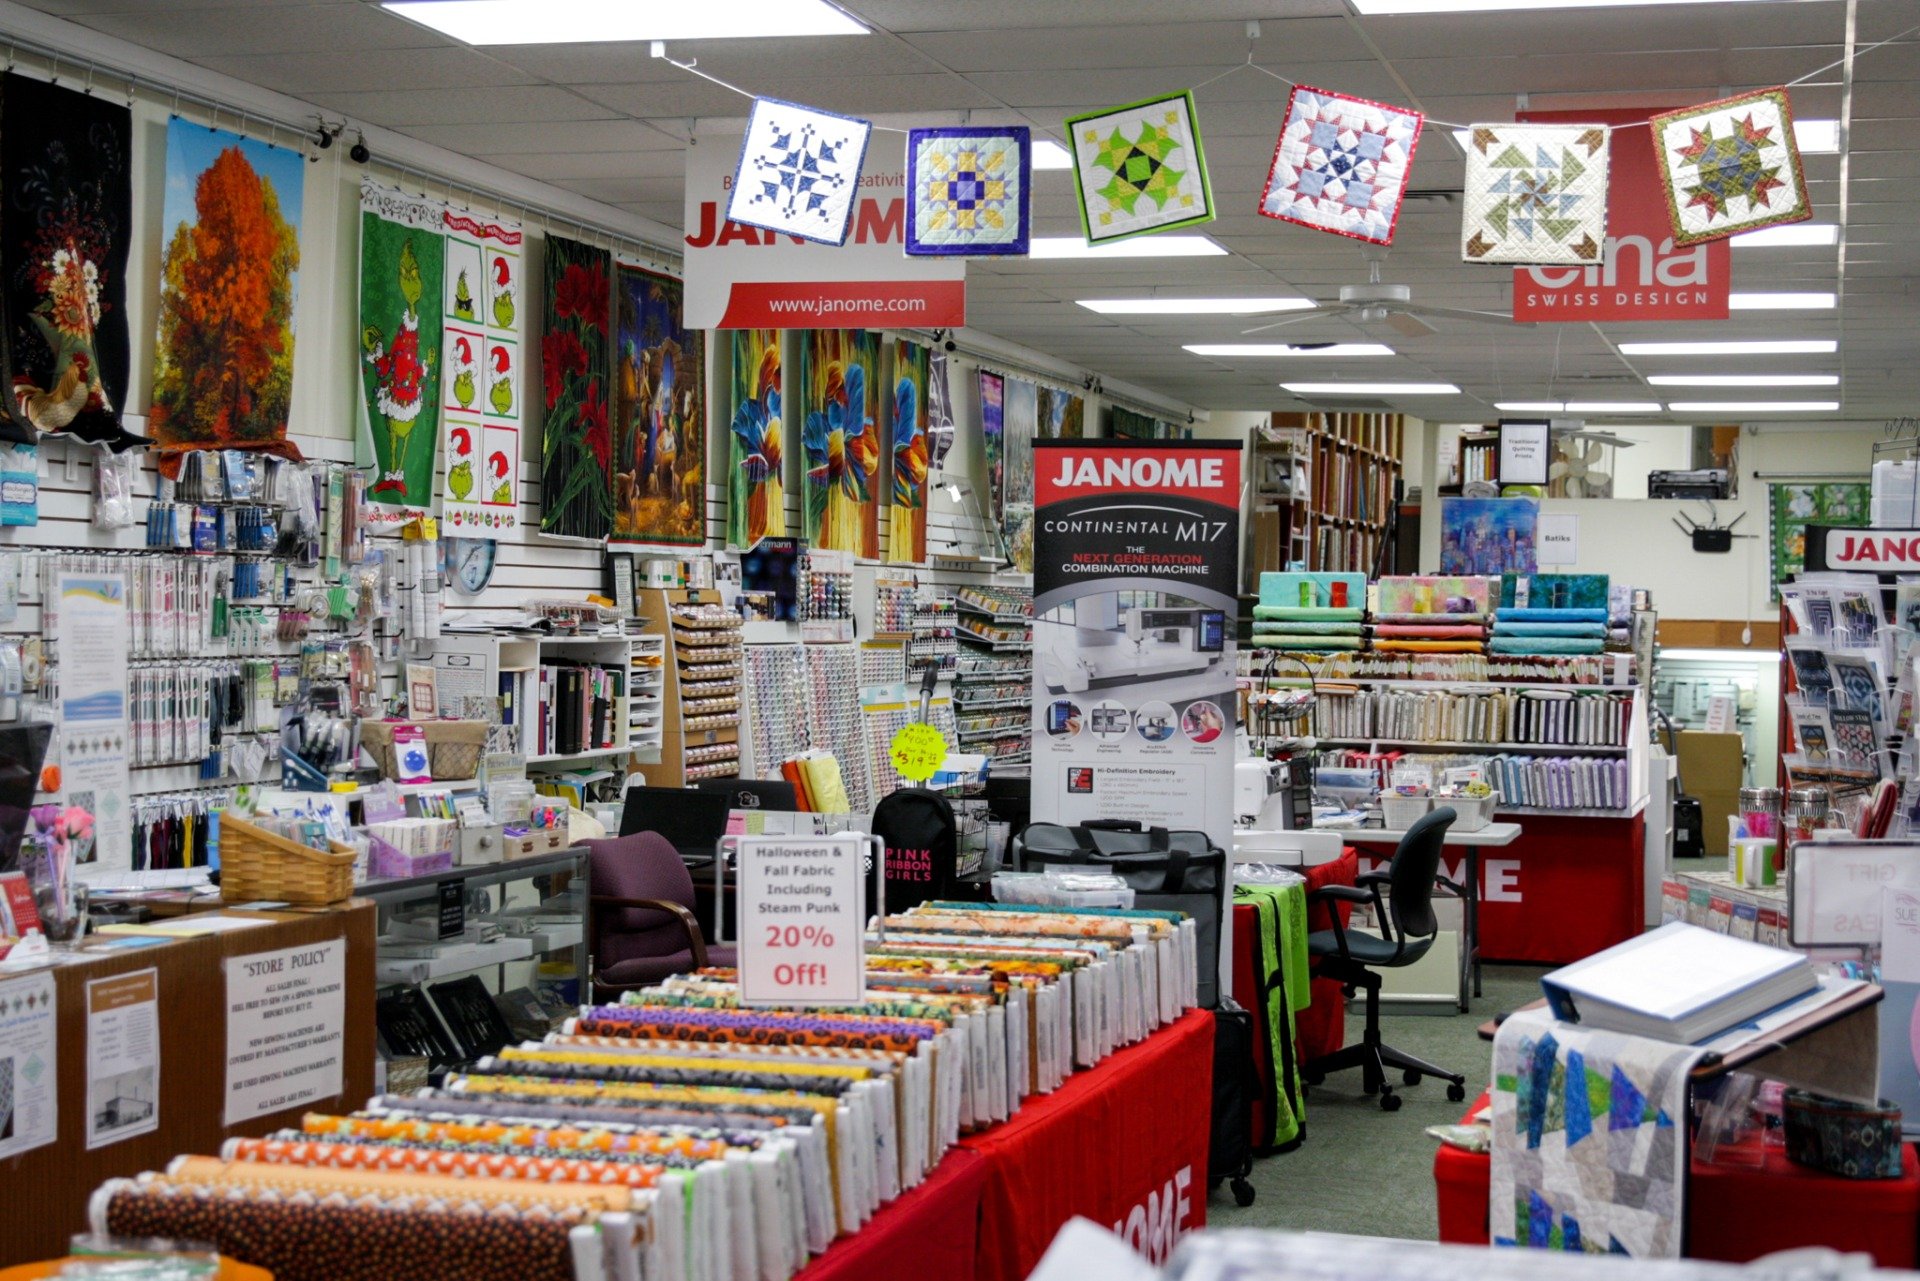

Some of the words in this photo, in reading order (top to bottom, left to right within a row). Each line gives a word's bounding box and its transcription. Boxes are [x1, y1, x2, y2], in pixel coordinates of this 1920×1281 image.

[1527, 293, 1600, 308] SWISS
[1615, 291, 1708, 306] DESIGN
[769, 296, 926, 316] www.janome.com
[1051, 456, 1224, 488] JANOME
[1044, 520, 1169, 535] CONTINENTAL
[1174, 521, 1228, 543] M17
[1544, 535, 1571, 543] Batiks
[1125, 546, 1146, 554] THE
[1073, 553, 1110, 564] NEXT
[1113, 553, 1203, 565] GENERATION
[1061, 563, 1149, 574] COMBINATION
[1151, 564, 1210, 575] MACHINE
[1138, 768, 1177, 776] Embroidery
[756, 847, 828, 858] Halloween
[833, 847, 843, 857] &
[885, 849, 931, 861] PINK
[764, 865, 789, 876] Fall
[793, 865, 835, 877] Fabric
[885, 861, 931, 871] RIBBON
[885, 870, 932, 881] GIRLS
[766, 884, 832, 897] Including
[758, 903, 801, 914] Steam
[806, 903, 841, 914] Punk
[765, 925, 835, 948] 20%
[773, 963, 828, 986] Off!
[231, 1002, 245, 1013] FEEL
[245, 1000, 260, 1011] FREE
[260, 999, 269, 1008] TO
[269, 996, 281, 1006] SEW
[295, 989, 316, 1000] SEWING
[316, 983, 342, 996] MACHINE
[262, 1009, 284, 1020] BEFORE
[249, 1039, 263, 1048] NEW
[263, 1035, 287, 1045] SEWING
[287, 1026, 314, 1039] MACHINES
[229, 1052, 255, 1066] COVERED
[232, 1081, 243, 1091] SEE
[243, 1077, 259, 1088] USED
[259, 1071, 282, 1084] SEWING
[282, 1064, 308, 1078] MACHINE
